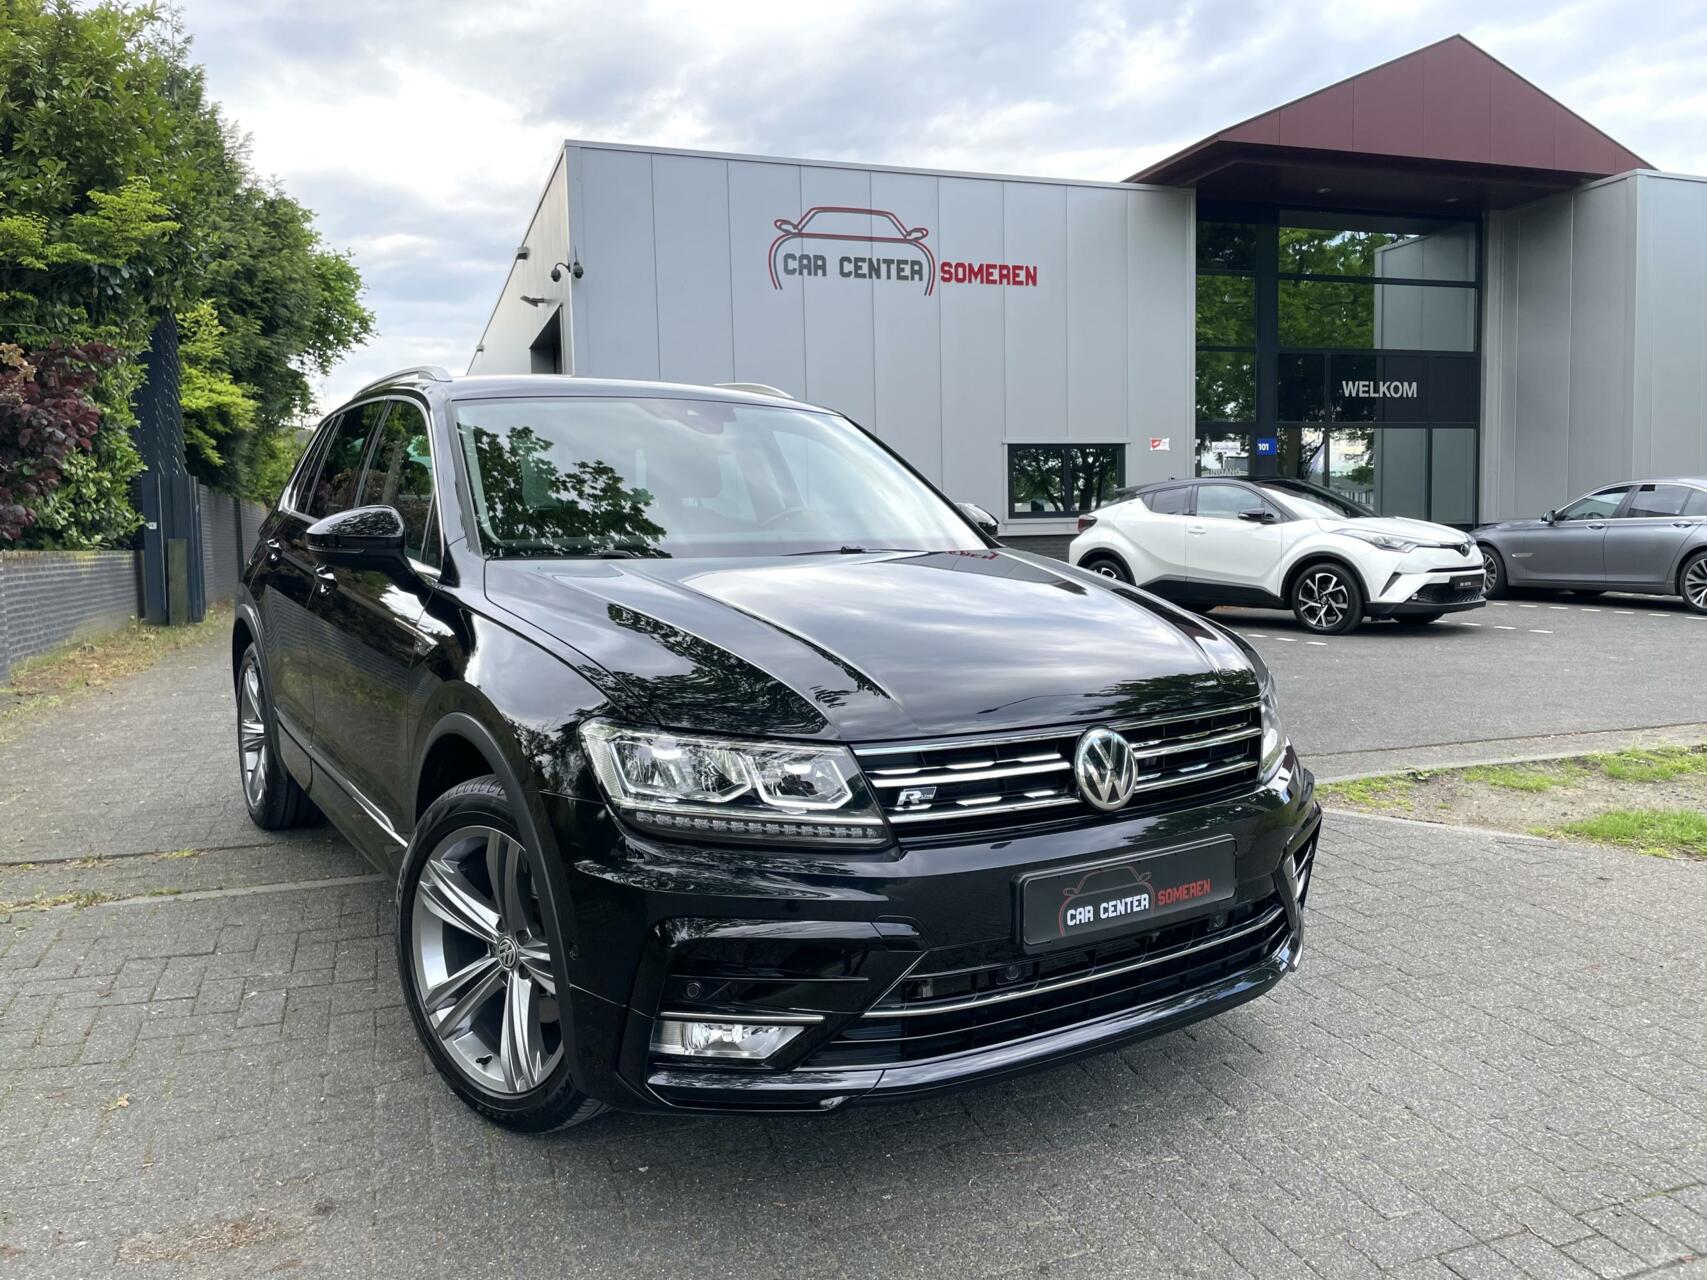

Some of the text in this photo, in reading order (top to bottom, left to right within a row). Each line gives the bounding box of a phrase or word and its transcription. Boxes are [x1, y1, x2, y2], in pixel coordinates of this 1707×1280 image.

[783, 253, 1038, 287] CAR CENTER SOMEREN
[1342, 380, 1418, 399] WELKOM
[1258, 443, 1269, 451] 101
[1066, 879, 1211, 926] CAR CENTER SOMEREN
